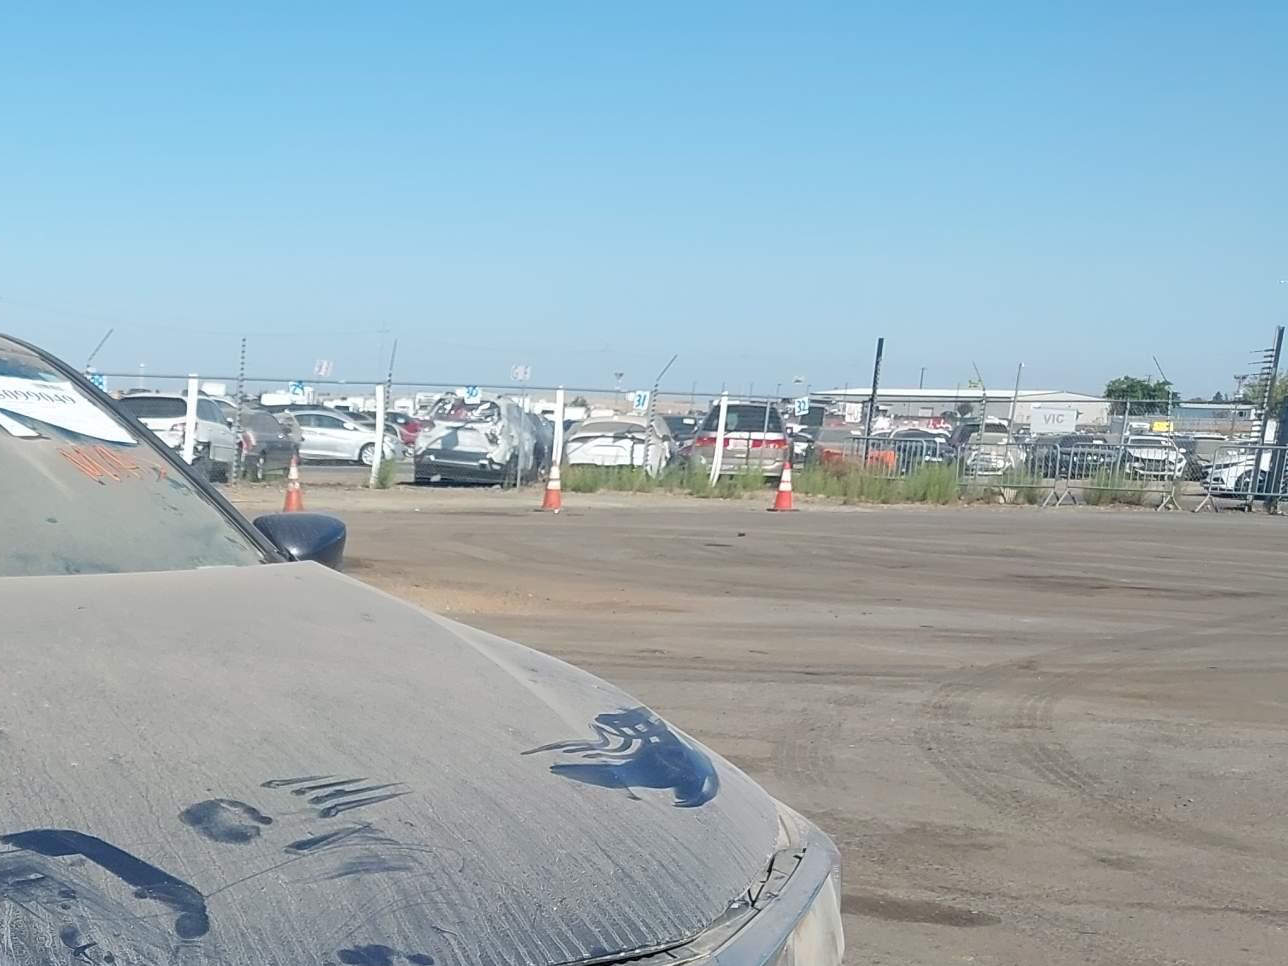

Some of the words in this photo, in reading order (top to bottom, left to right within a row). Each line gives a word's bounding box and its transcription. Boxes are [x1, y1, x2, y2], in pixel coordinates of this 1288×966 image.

[634, 393, 648, 409] 31
[795, 399, 809, 414] 32
[1043, 413, 1065, 425] VIC
